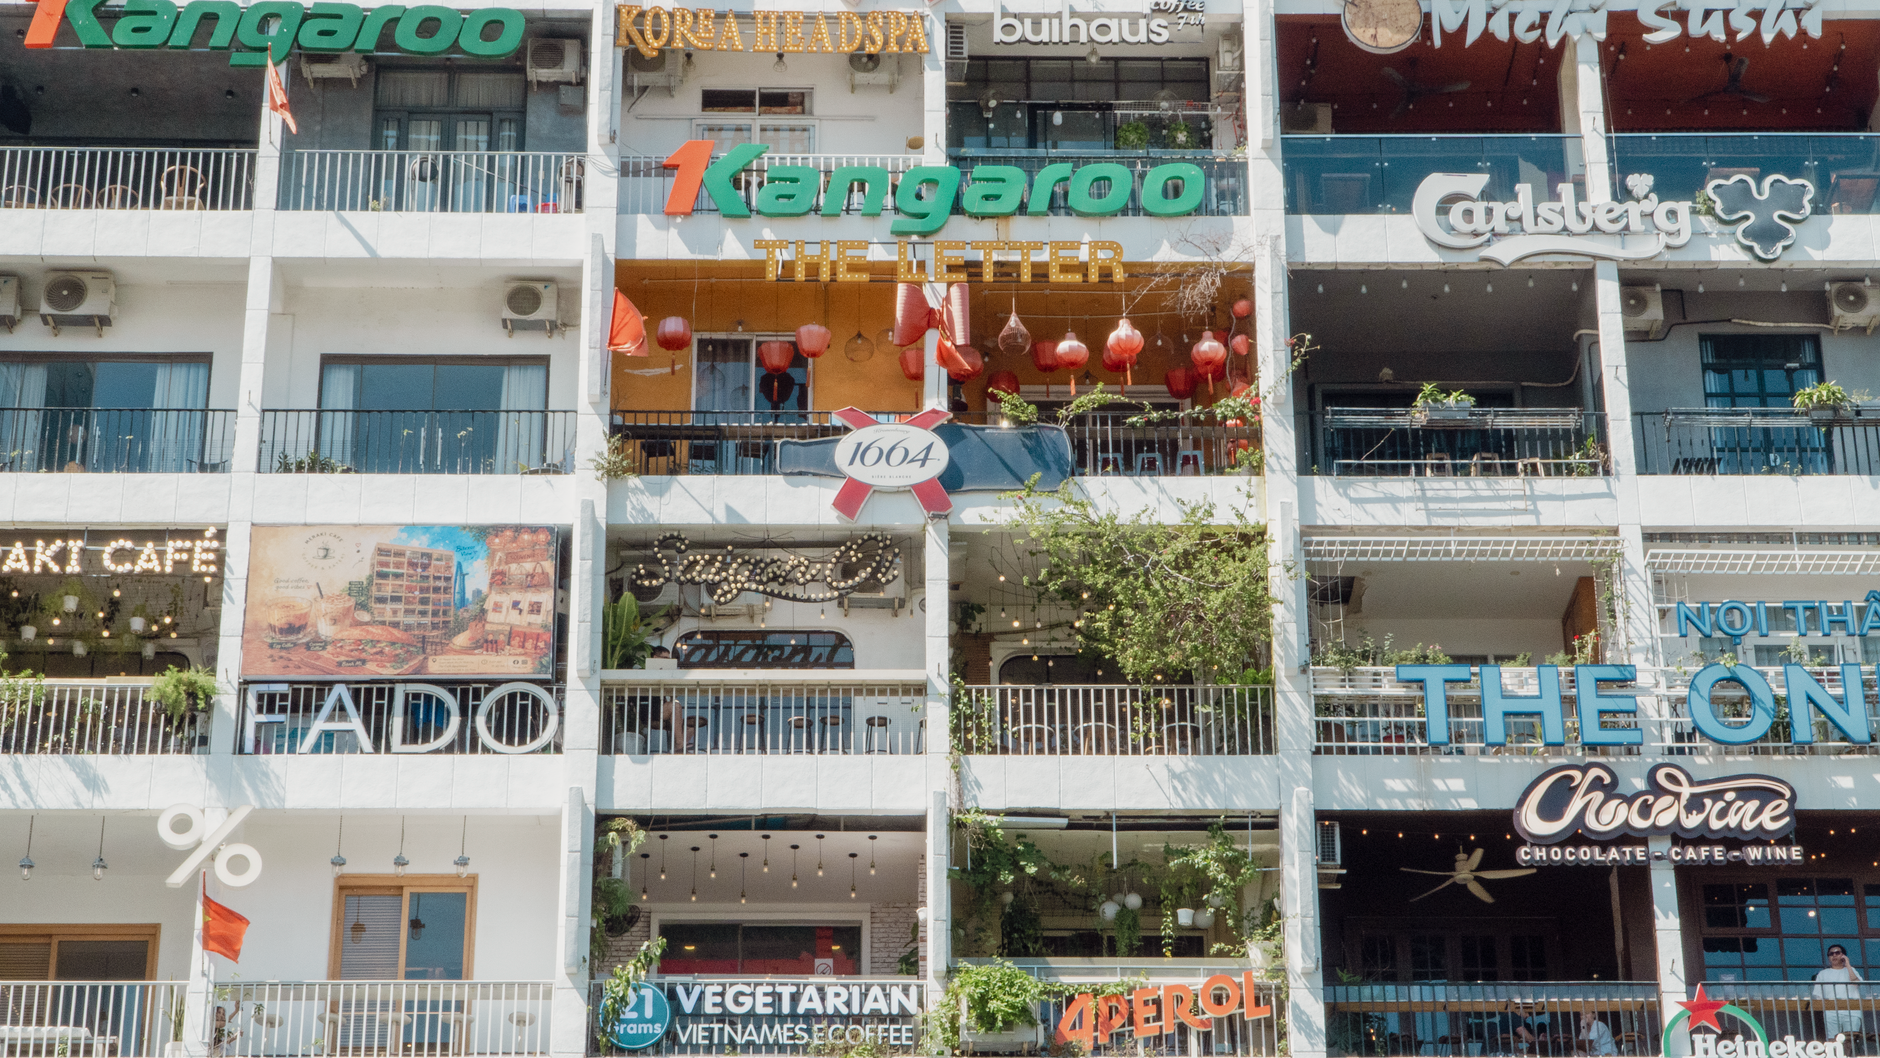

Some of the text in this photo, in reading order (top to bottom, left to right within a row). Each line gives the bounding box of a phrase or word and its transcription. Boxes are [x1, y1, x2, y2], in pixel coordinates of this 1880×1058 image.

[616, 4, 745, 57] KOREA
[993, 0, 1170, 45] buihaus
[1412, 172, 1692, 249] Carlsberg
[754, 239, 1124, 282] THE LETTER
[847, 436, 941, 469] 1664
[0, 526, 218, 574] AKI CAFÉ
[304, 531, 328, 545] MERAKI
[244, 681, 559, 754] FADO
[1396, 662, 1880, 747] THE ON
[1520, 846, 1803, 861] CHOCOLATE CAFE WINE
[675, 984, 918, 1015] VEGETARIAN
[1056, 970, 1271, 1051] APEROL
[828, 1024, 913, 1045] COFFEE
[1692, 1033, 1846, 1058] Heineken
